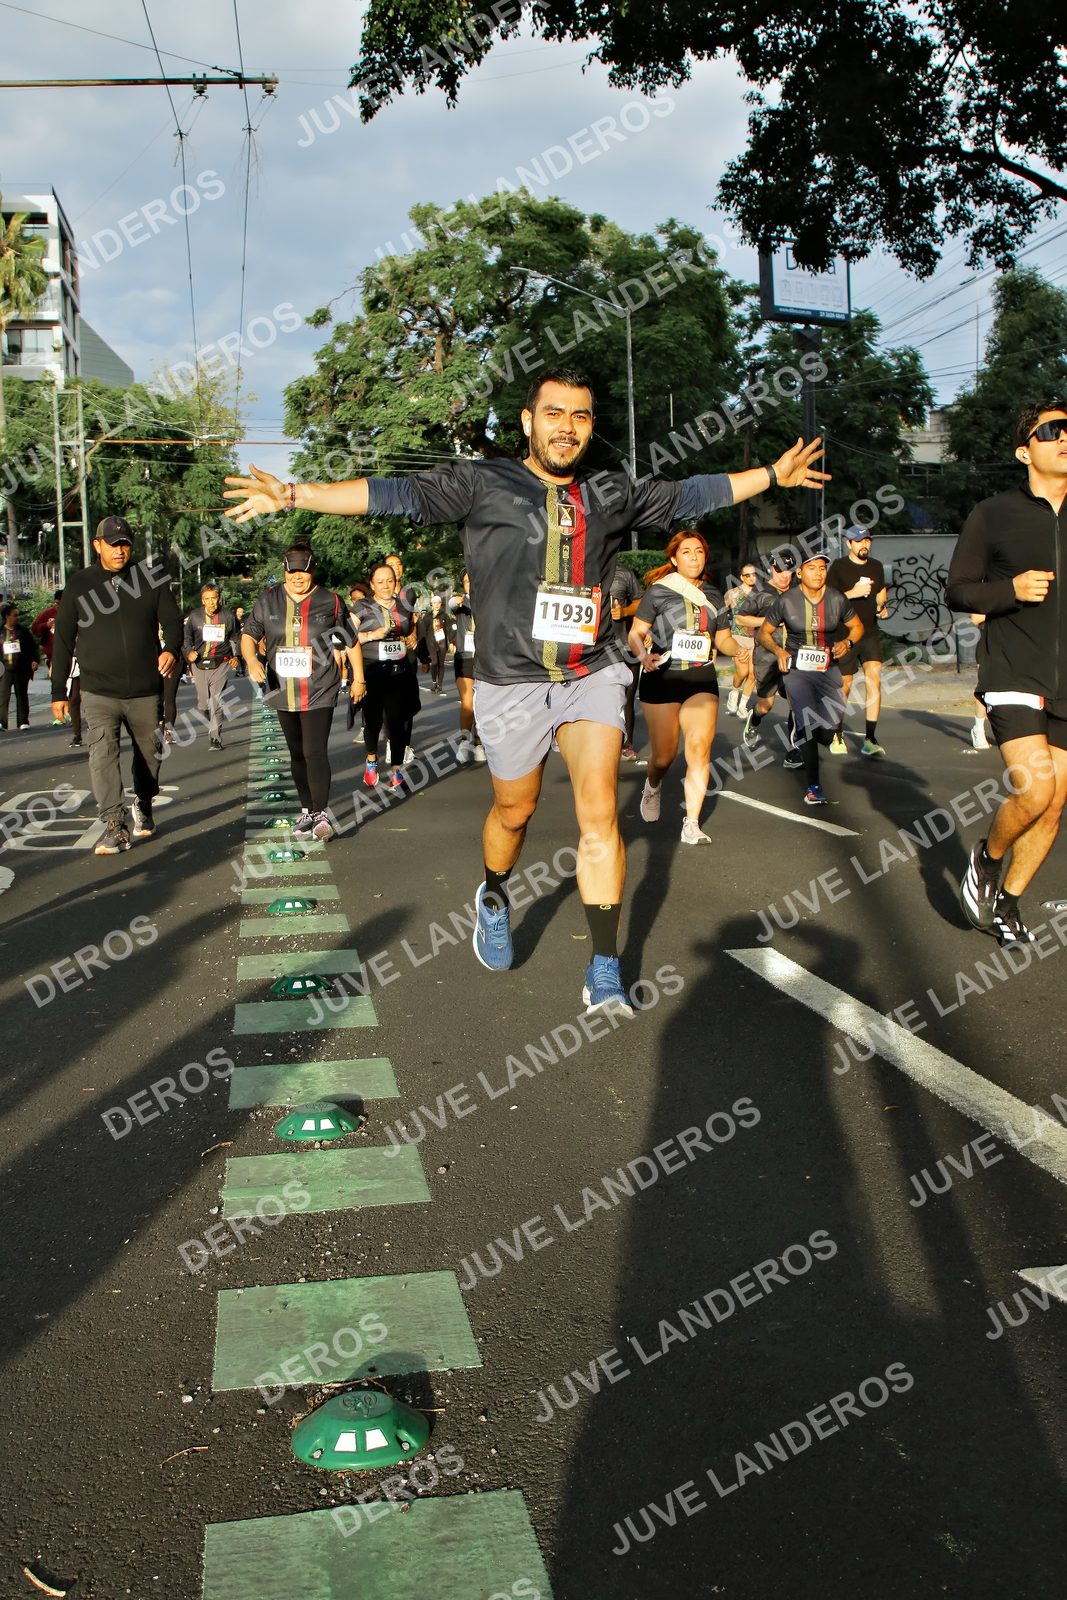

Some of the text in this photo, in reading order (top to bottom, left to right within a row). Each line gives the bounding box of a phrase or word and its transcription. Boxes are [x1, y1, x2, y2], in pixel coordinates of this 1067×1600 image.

[893, 553, 935, 569] TOY
[540, 601, 594, 624] 11939
[384, 644, 401, 653] 4634
[678, 639, 703, 650] 4080
[278, 656, 307, 667] 10296
[800, 653, 826, 663] 13005
